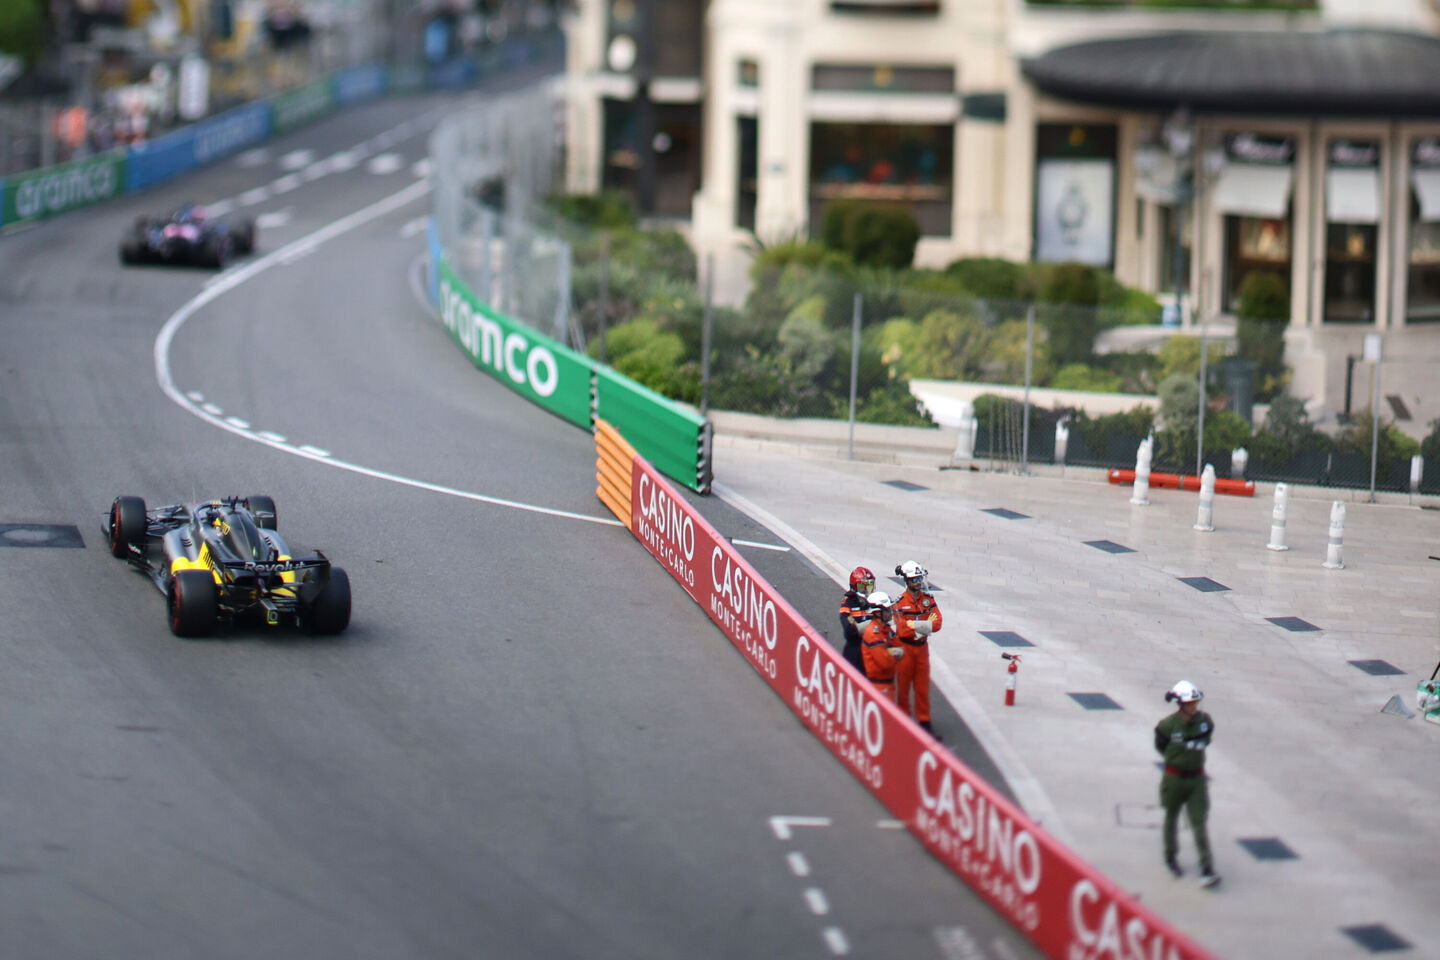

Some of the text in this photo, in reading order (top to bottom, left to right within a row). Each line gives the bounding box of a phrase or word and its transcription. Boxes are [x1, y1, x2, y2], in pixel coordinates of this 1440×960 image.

[440, 280, 559, 397] aramco
[244, 560, 305, 573] Revolut
[639, 472, 695, 562] CASINO
[711, 545, 777, 650] CASINO
[795, 635, 884, 757] CASINO
[918, 750, 1042, 895] CASINO
[1070, 878, 1182, 960] CAS
